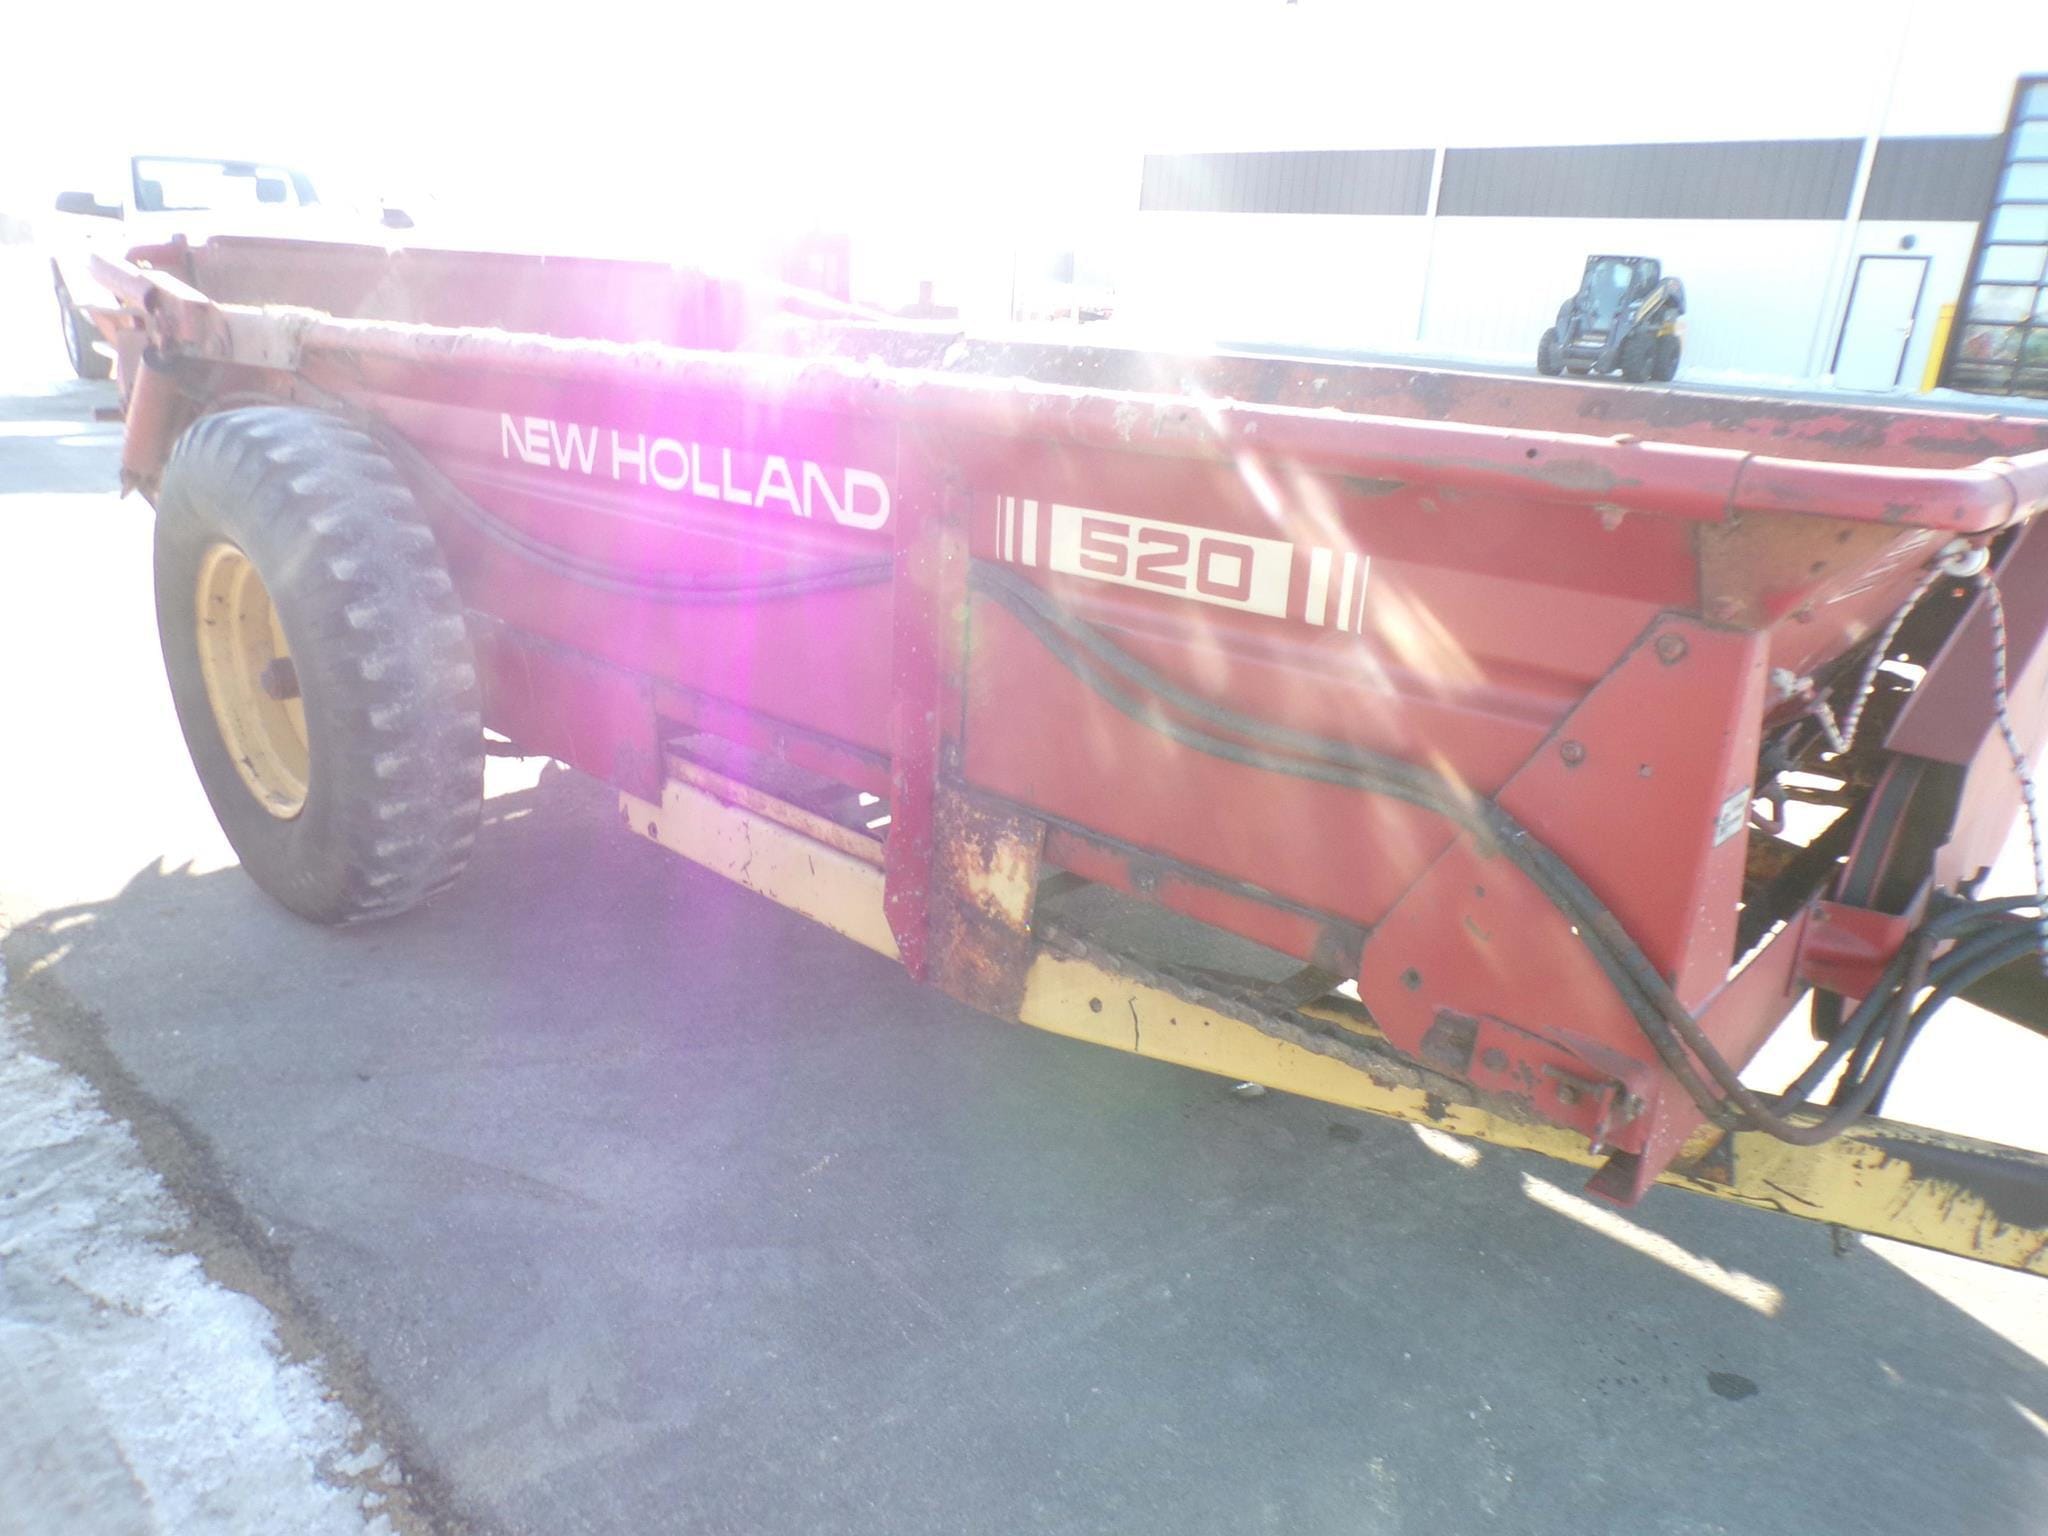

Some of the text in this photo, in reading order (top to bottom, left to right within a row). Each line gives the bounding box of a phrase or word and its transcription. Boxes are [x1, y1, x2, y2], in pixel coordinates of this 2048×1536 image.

[500, 412, 891, 531] NEW HOLLAND
[1079, 516, 1255, 602] 520
